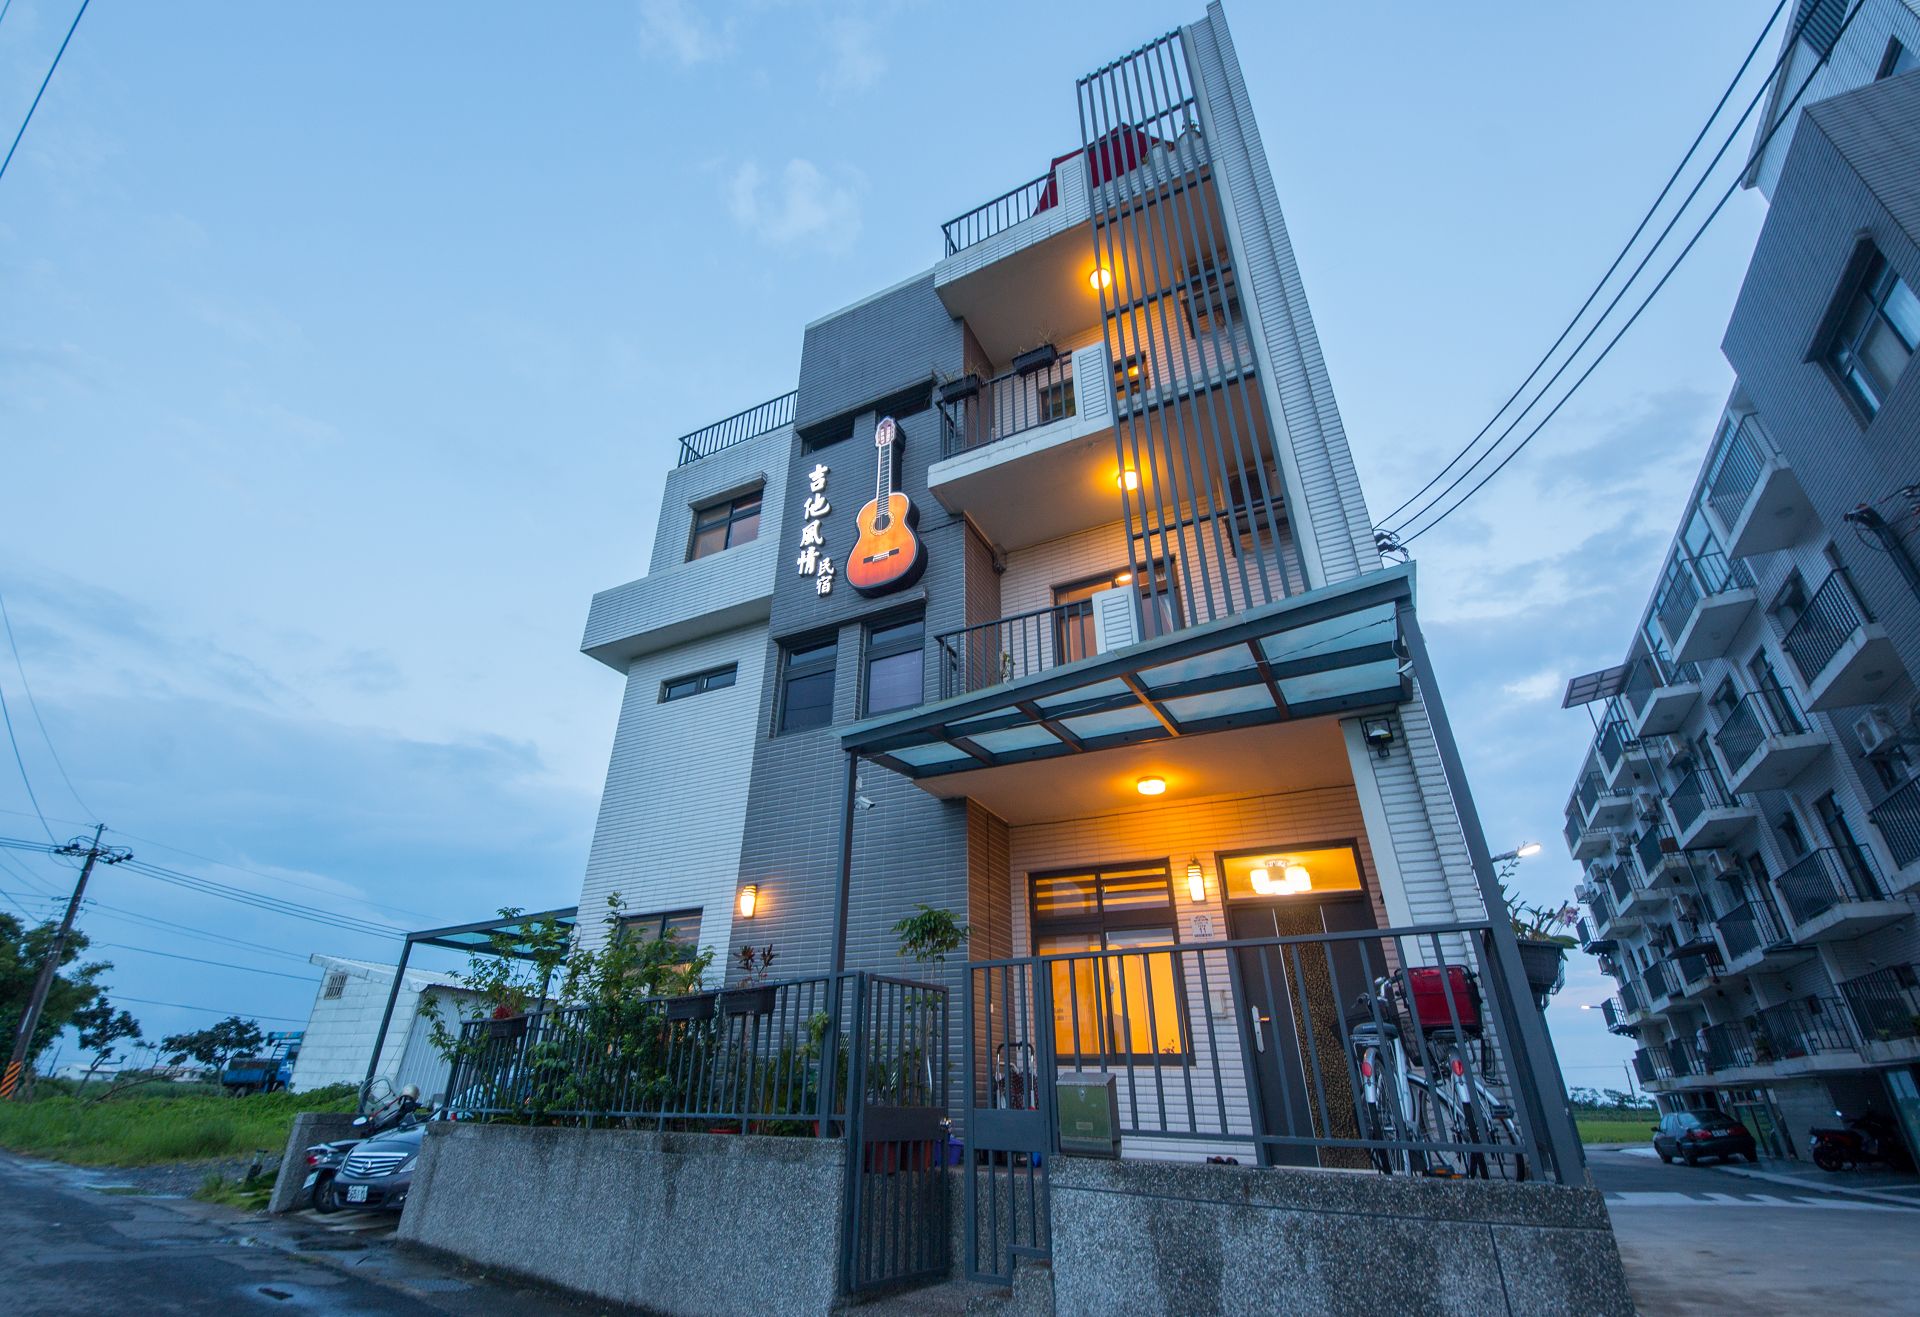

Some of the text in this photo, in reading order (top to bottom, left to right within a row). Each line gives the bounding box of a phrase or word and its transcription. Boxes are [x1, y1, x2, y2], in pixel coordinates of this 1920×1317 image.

[797, 464, 831, 574] 吉他風情
[816, 557, 834, 595] 民宿
